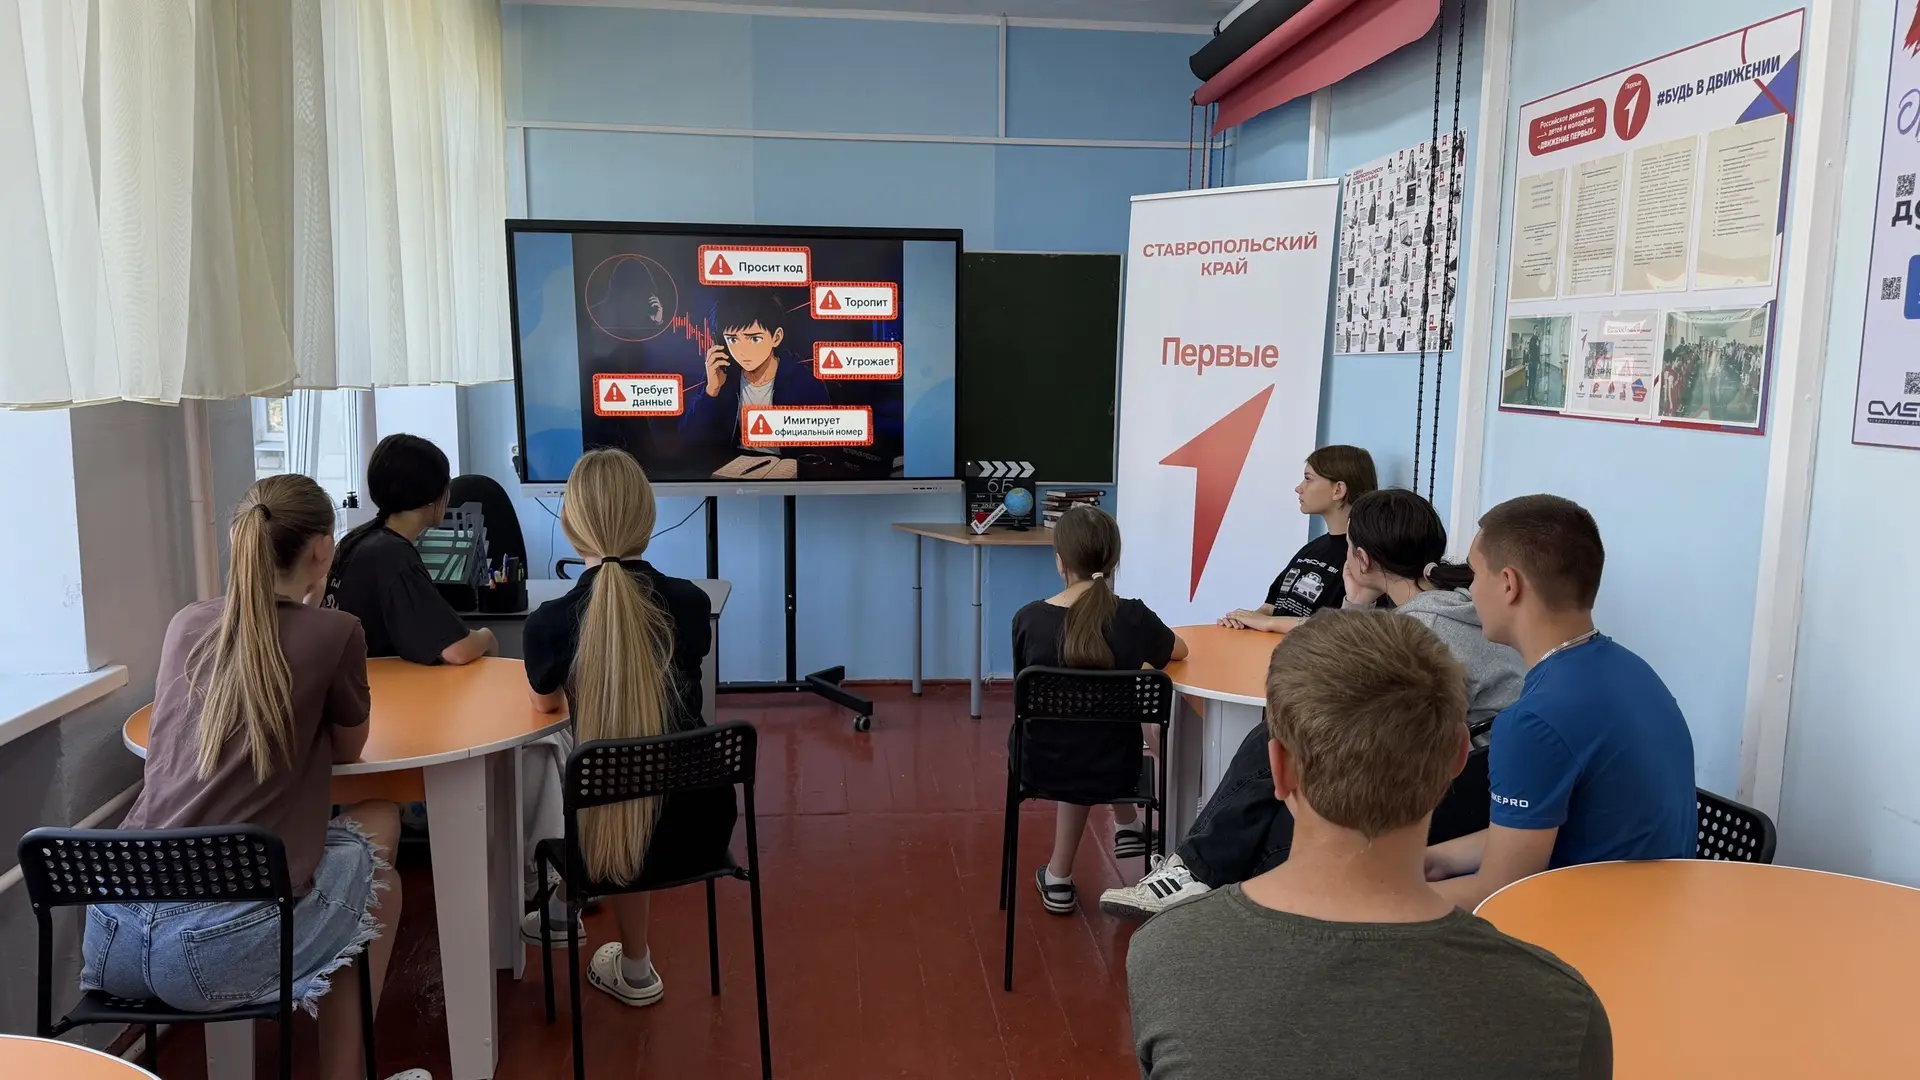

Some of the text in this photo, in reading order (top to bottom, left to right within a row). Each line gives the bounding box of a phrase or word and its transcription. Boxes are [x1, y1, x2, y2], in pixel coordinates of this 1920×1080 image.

[1656, 55, 1781, 107] #БУДЬ В ДВИЖЕНИИ
[1539, 106, 1596, 129] Российское движение
[1548, 124, 1563, 137] детей
[1567, 116, 1595, 130] молодёжи
[1537, 127, 1597, 150] «ДВИЖЕНИЕ ПЕРВЫХ»
[1143, 231, 1318, 258] СТАВРОПОЛЬСКИЙ
[739, 261, 804, 274] Просит код
[1201, 257, 1248, 276] КРАЙ
[844, 297, 888, 309] Торопит
[845, 355, 895, 369] Угрожает
[1162, 337, 1279, 376] Первые
[630, 384, 674, 397] Требует
[632, 397, 673, 407] данные
[783, 415, 841, 427] Имитирует
[774, 427, 863, 438] официальный номер
